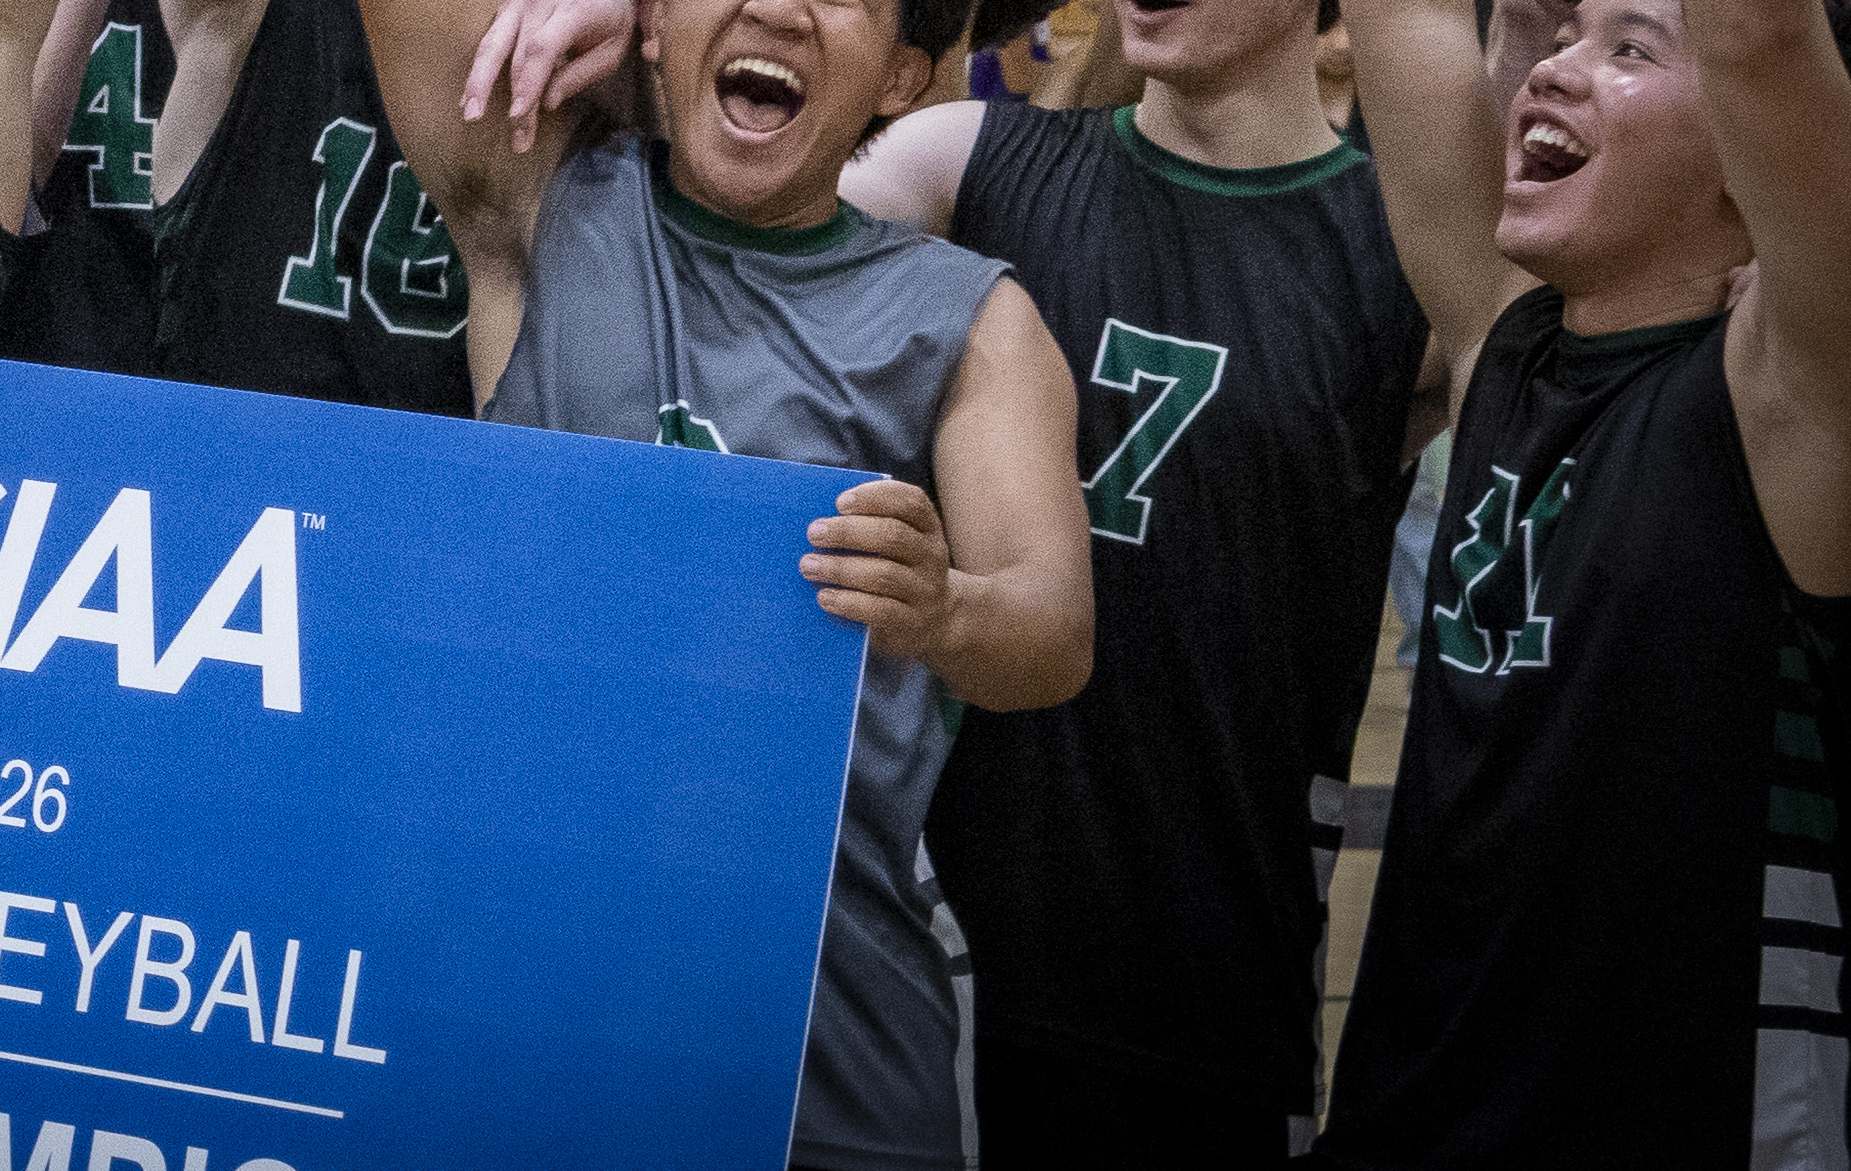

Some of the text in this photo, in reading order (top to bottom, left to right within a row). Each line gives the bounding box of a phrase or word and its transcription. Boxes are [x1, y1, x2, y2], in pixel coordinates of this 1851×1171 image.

[62, 21, 158, 210] 4
[278, 116, 470, 339] 16
[1081, 317, 1230, 546] 7
